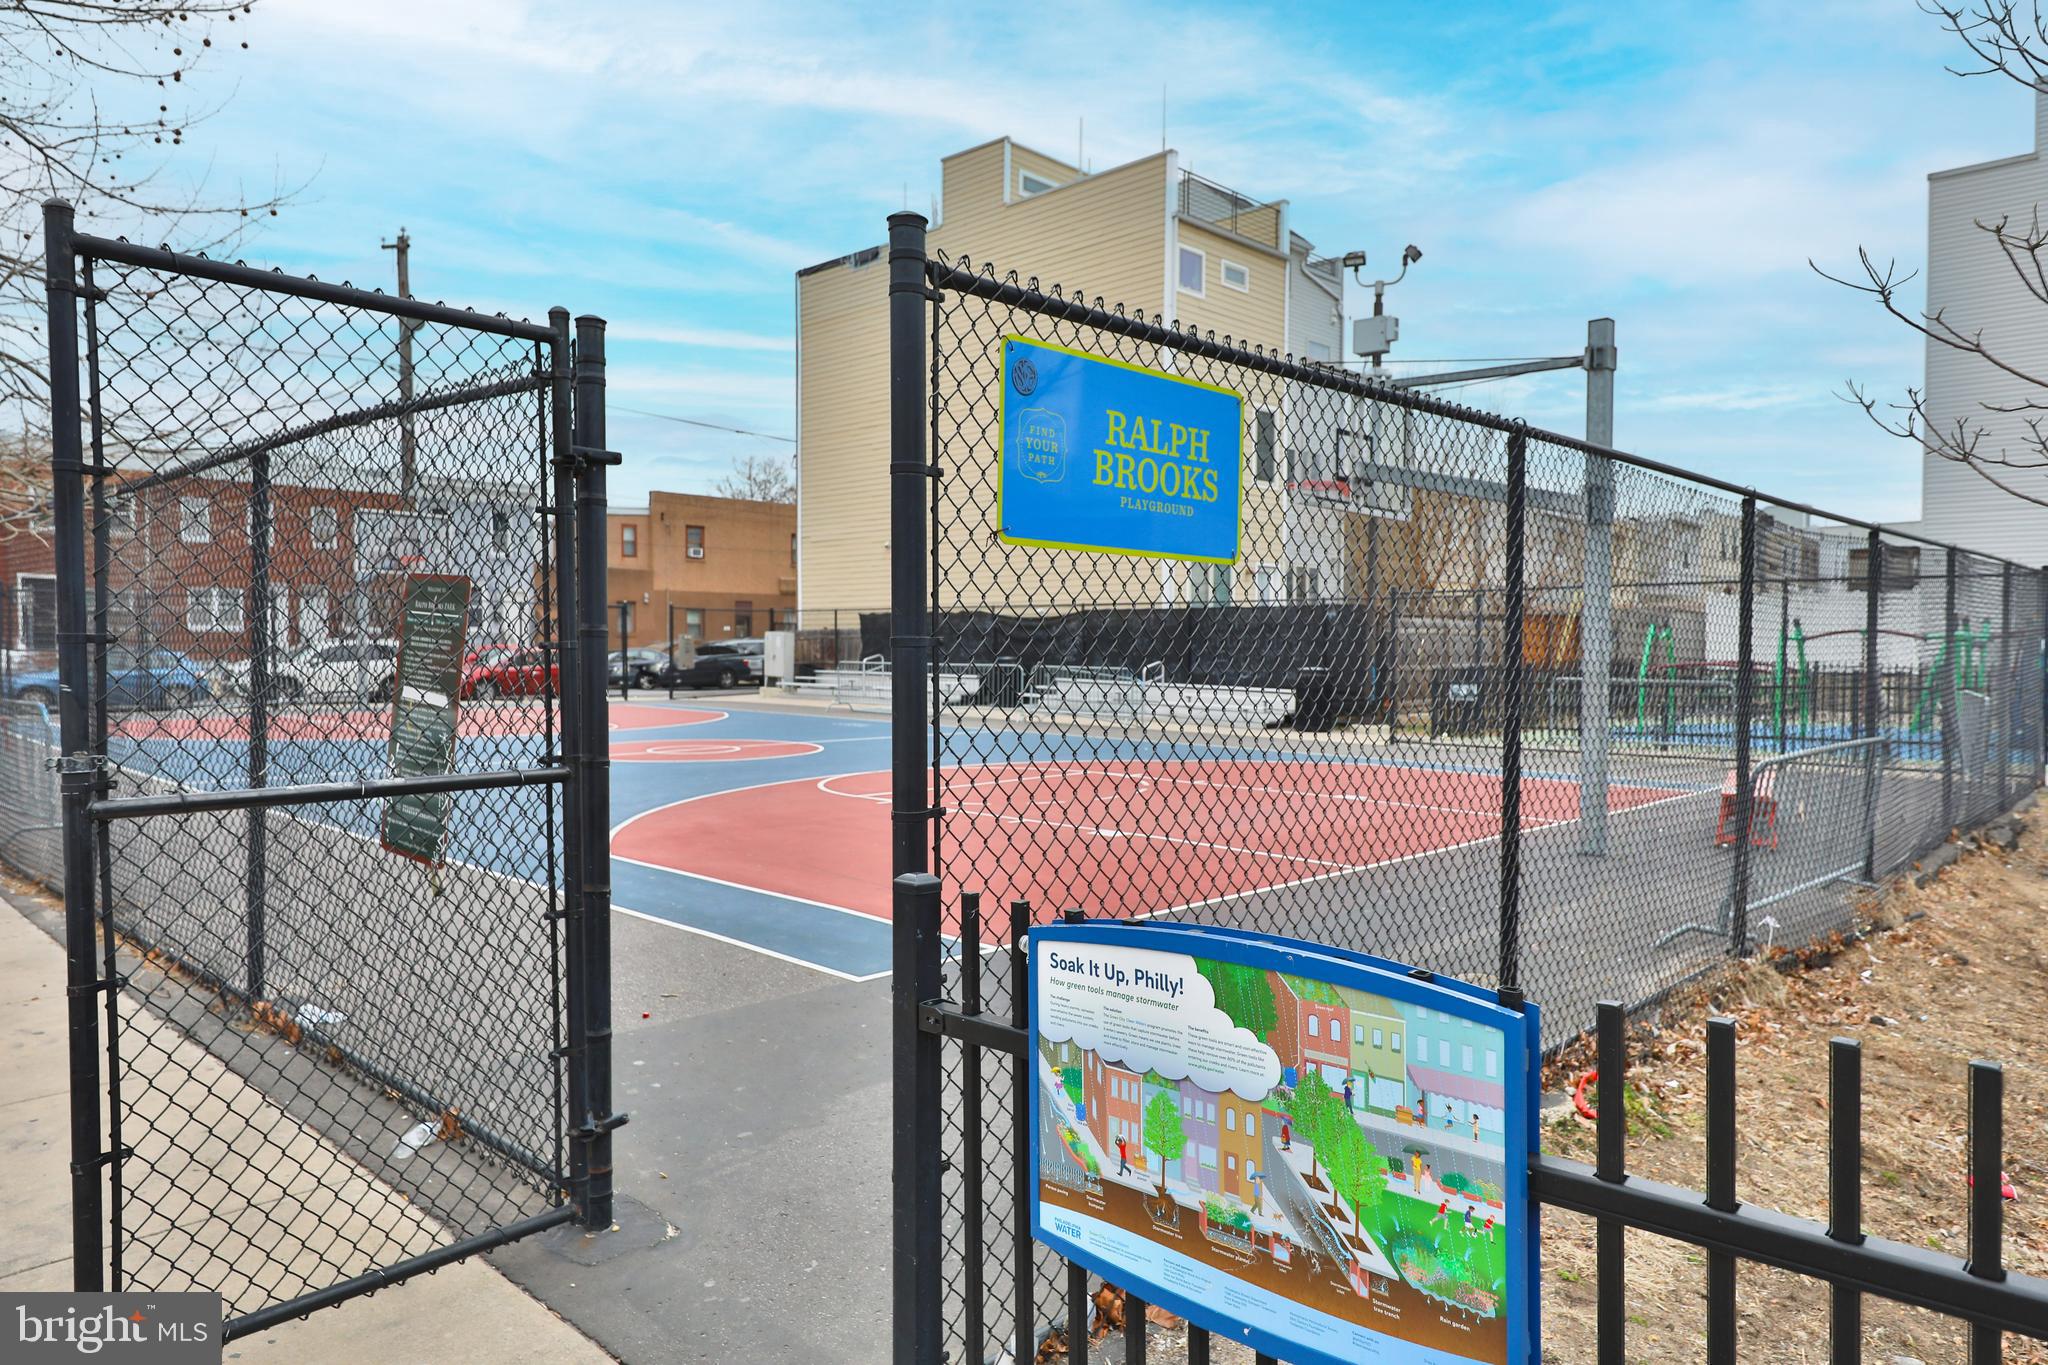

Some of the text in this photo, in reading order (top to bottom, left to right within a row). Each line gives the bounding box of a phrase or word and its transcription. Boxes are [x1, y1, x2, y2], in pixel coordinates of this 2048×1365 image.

[1030, 425, 1055, 437] FIND
[1105, 409, 1210, 463] RALPH
[1025, 437, 1059, 454] YOUR
[1028, 453, 1056, 466] PATH
[1092, 449, 1218, 502] BROOKS
[1120, 496, 1194, 517] PLAYGROUND
[1050, 952, 1184, 998] Soak It Up, Philly!
[1050, 976, 1179, 1012] How green tools manage stormwater
[1055, 1222, 1081, 1239] WATER
[1372, 1298, 1400, 1313] Stormwater
[1385, 1310, 1400, 1320] trench
[1440, 1316, 1471, 1332] Rain garden
